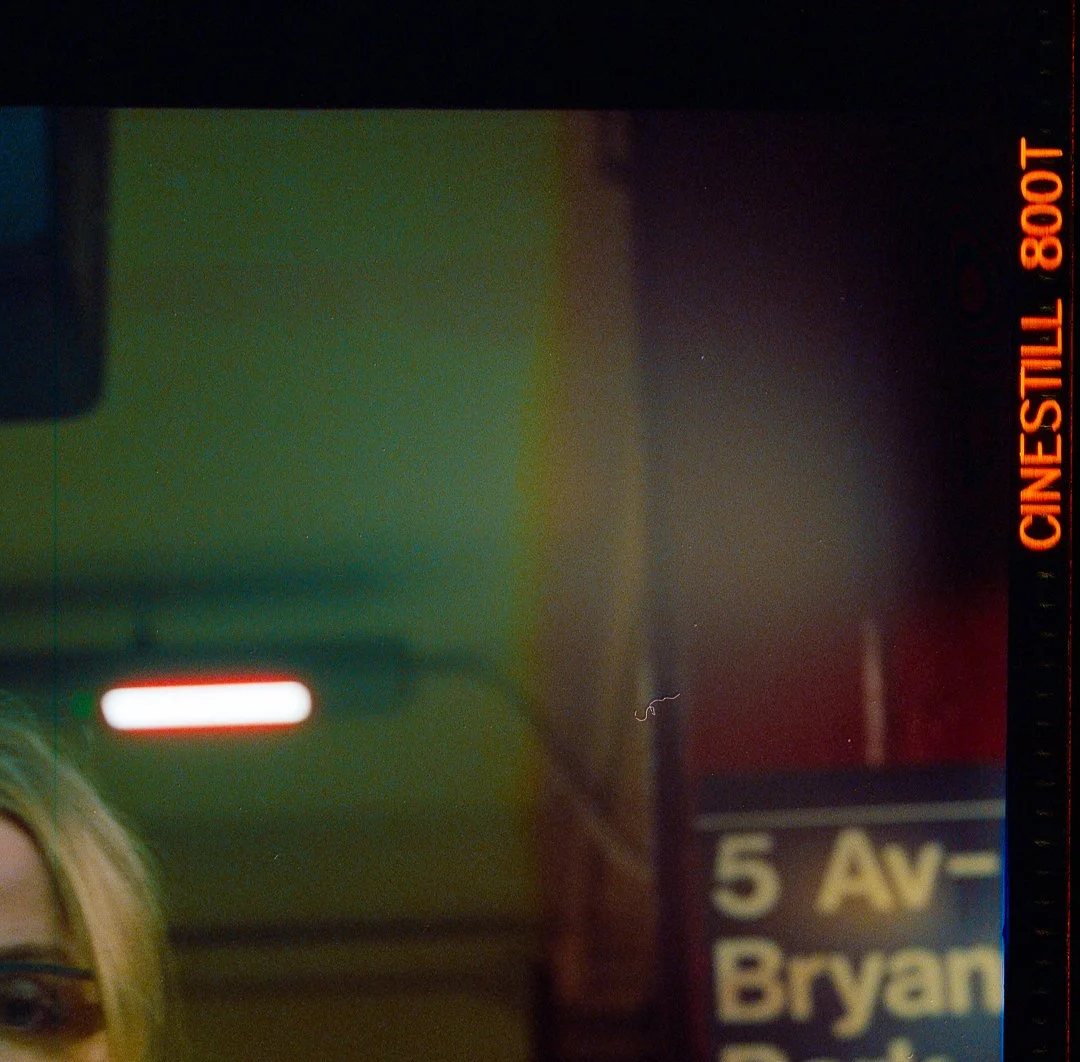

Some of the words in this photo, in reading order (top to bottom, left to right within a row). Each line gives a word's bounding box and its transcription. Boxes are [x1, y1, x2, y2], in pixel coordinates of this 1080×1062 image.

[1019, 136, 1064, 272] 800T
[1019, 298, 1063, 552] CINESTILL
[712, 831, 782, 921] 5
[712, 935, 1004, 1040] Bryan
